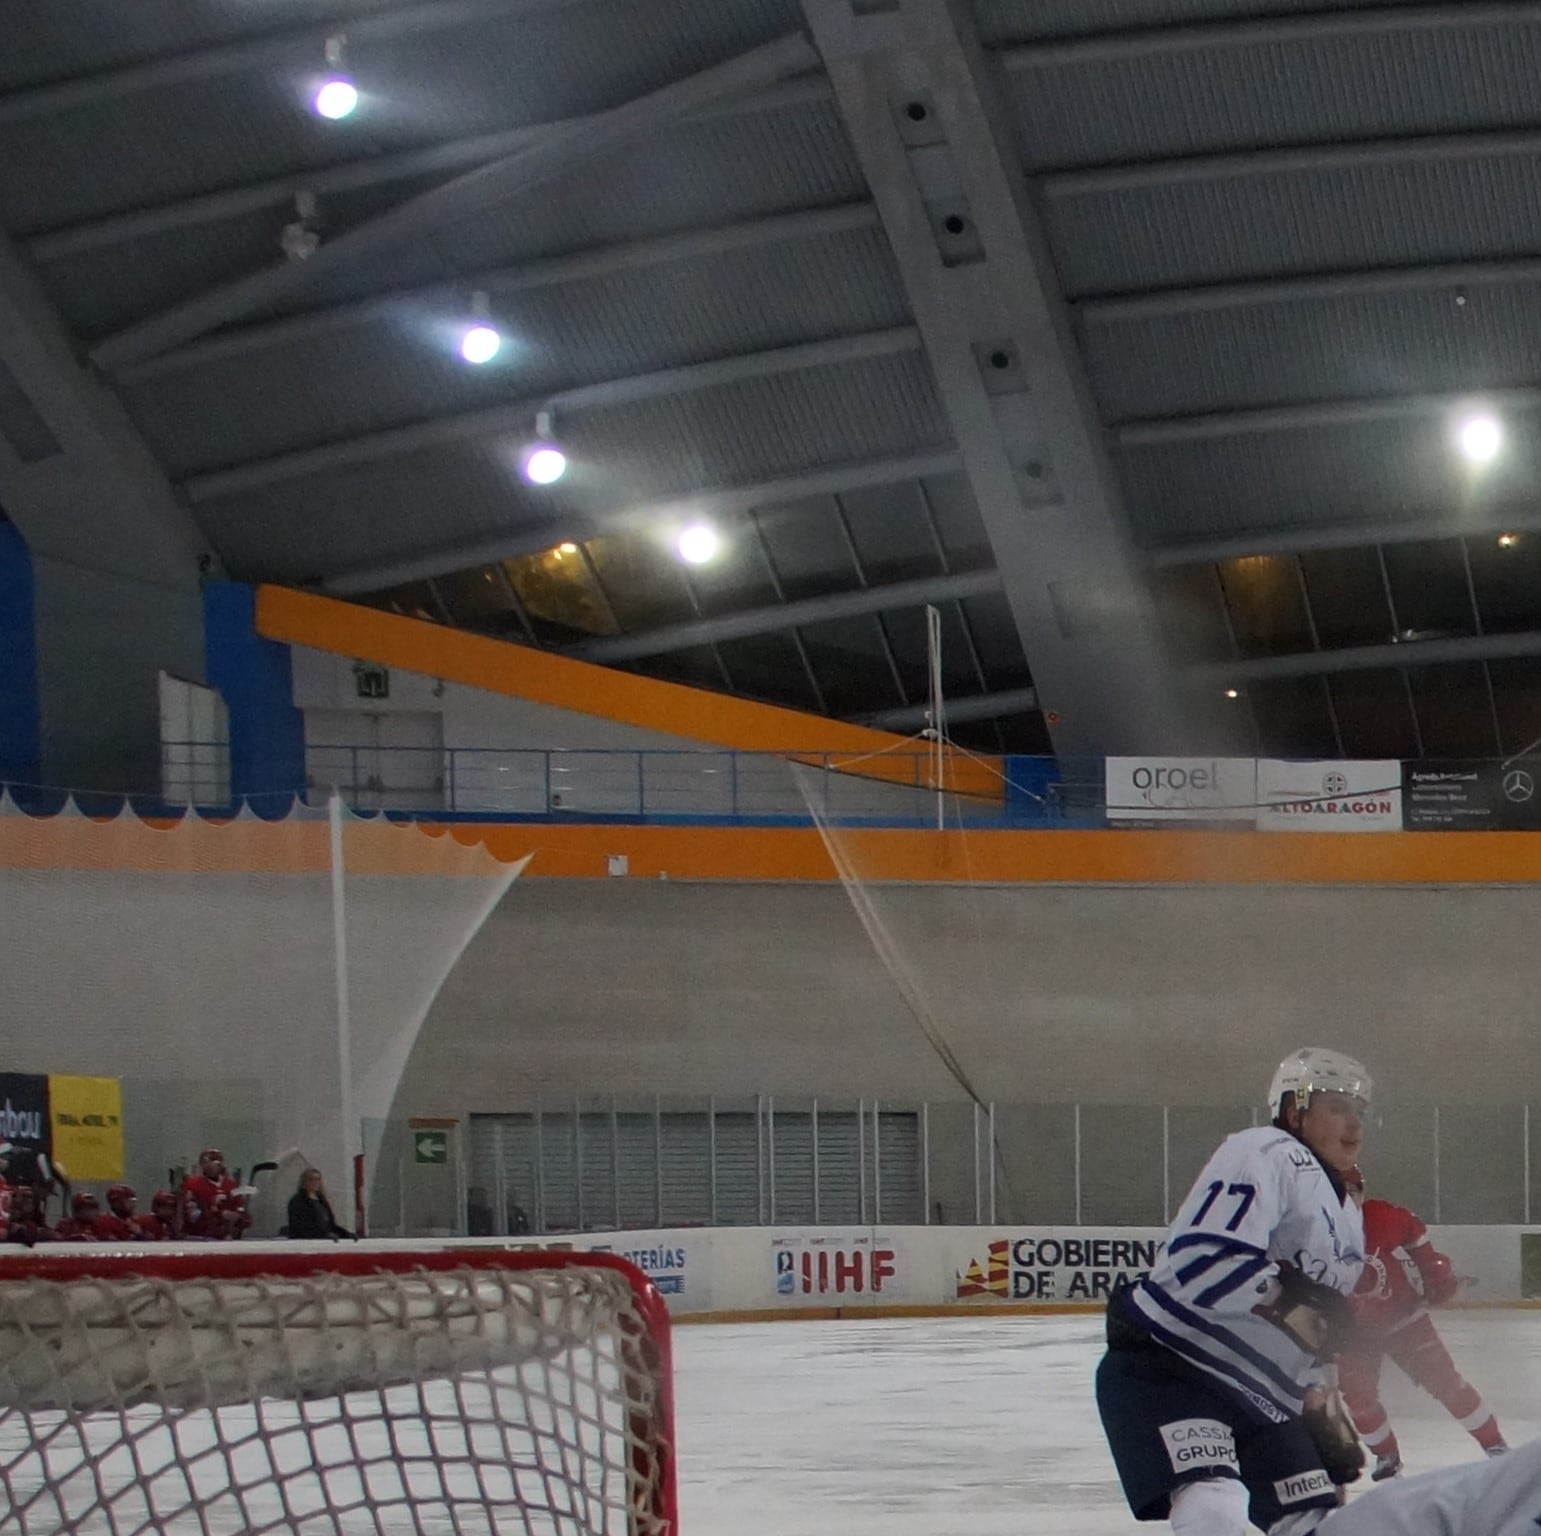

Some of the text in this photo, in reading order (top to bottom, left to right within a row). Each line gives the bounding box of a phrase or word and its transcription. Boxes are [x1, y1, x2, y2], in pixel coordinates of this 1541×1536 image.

[1132, 762, 1218, 790] oroel
[1190, 1180, 1256, 1232] 17
[1012, 1239, 1166, 1268] GOBIERN
[801, 1250, 896, 1294] IIHF
